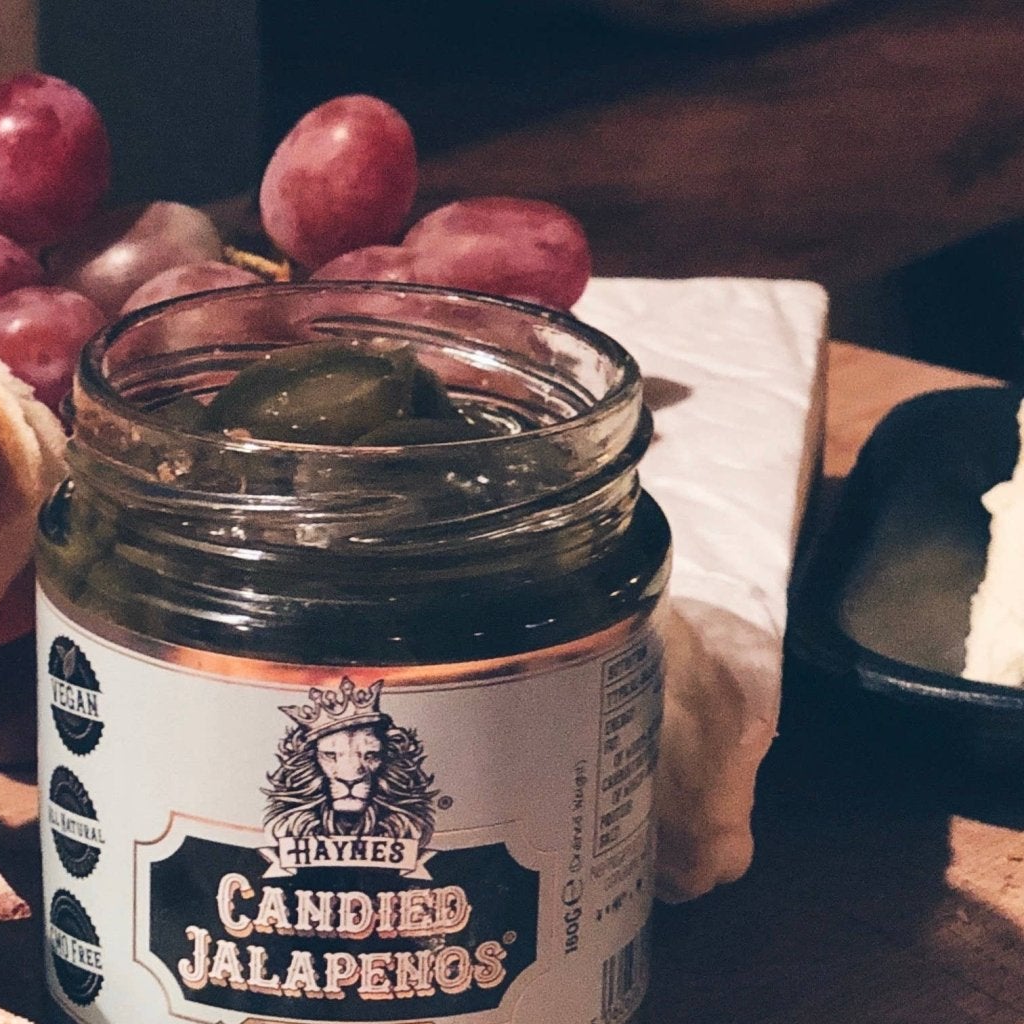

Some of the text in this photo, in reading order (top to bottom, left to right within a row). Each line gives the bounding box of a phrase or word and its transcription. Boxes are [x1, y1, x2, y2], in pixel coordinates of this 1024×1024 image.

[50, 678, 99, 718] VEGAN
[293, 837, 407, 865] HAYNES
[216, 872, 473, 941] CANDIED
[71, 939, 103, 970] FREE
